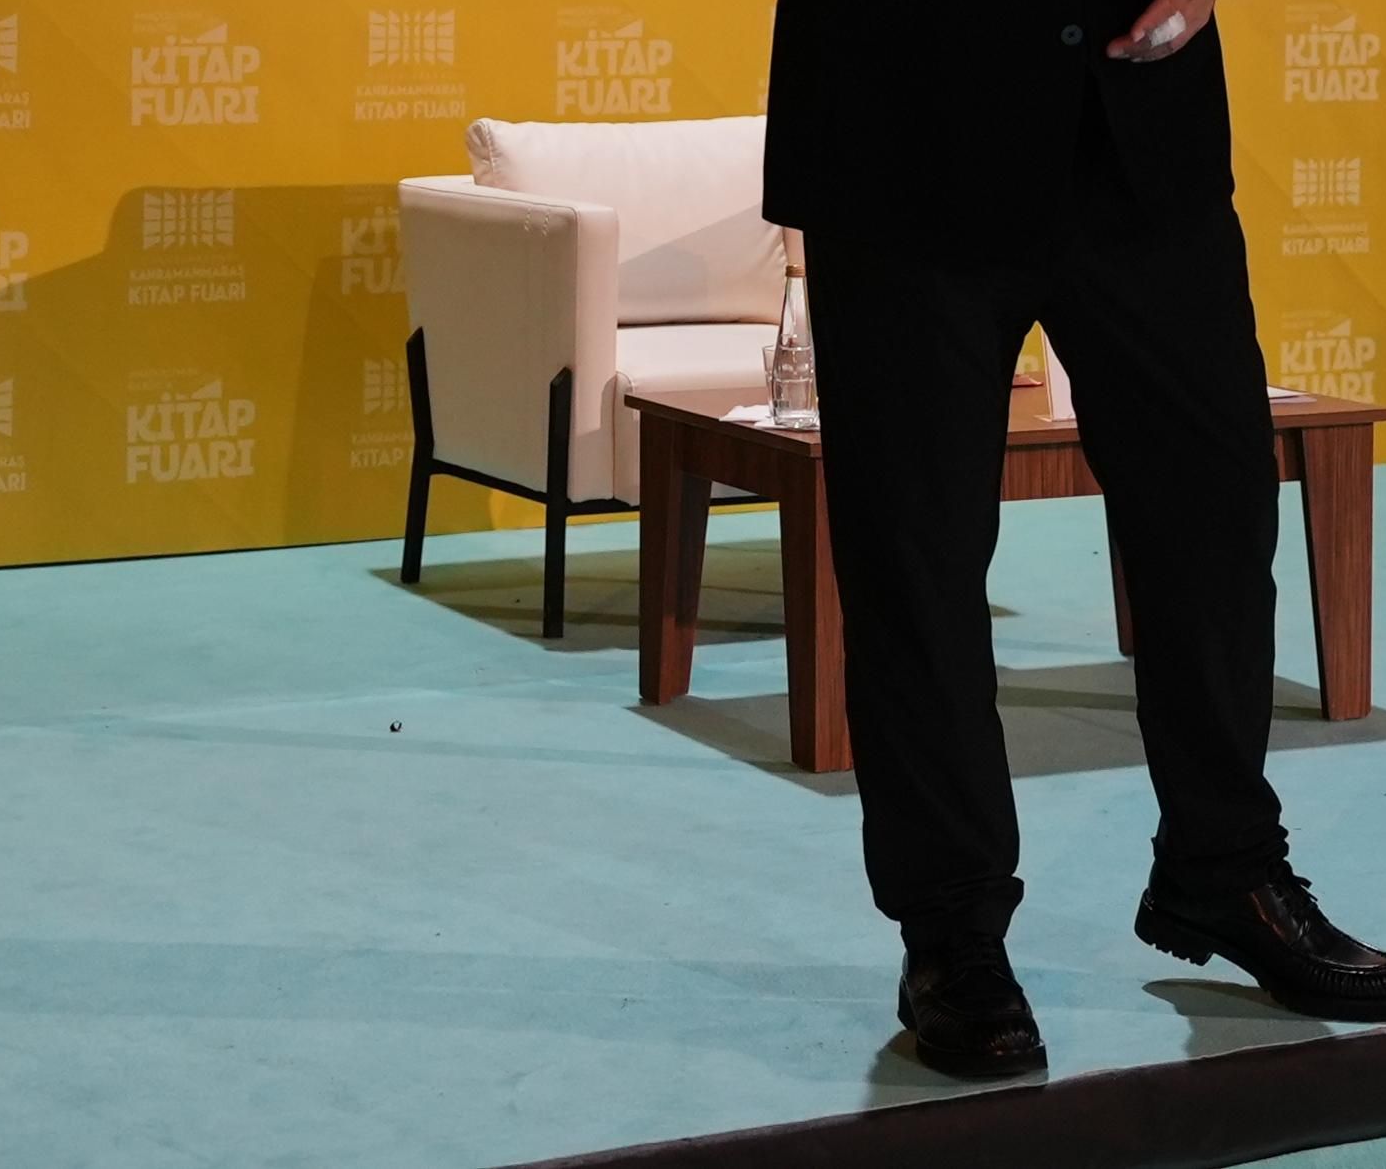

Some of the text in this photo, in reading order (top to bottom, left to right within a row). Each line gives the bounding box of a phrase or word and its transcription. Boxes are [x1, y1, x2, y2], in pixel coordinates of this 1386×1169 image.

[557, 78, 671, 114] FUARI
[1285, 69, 1380, 103] FUARI
[132, 87, 259, 126] FUARI
[126, 439, 255, 484] FUARI
